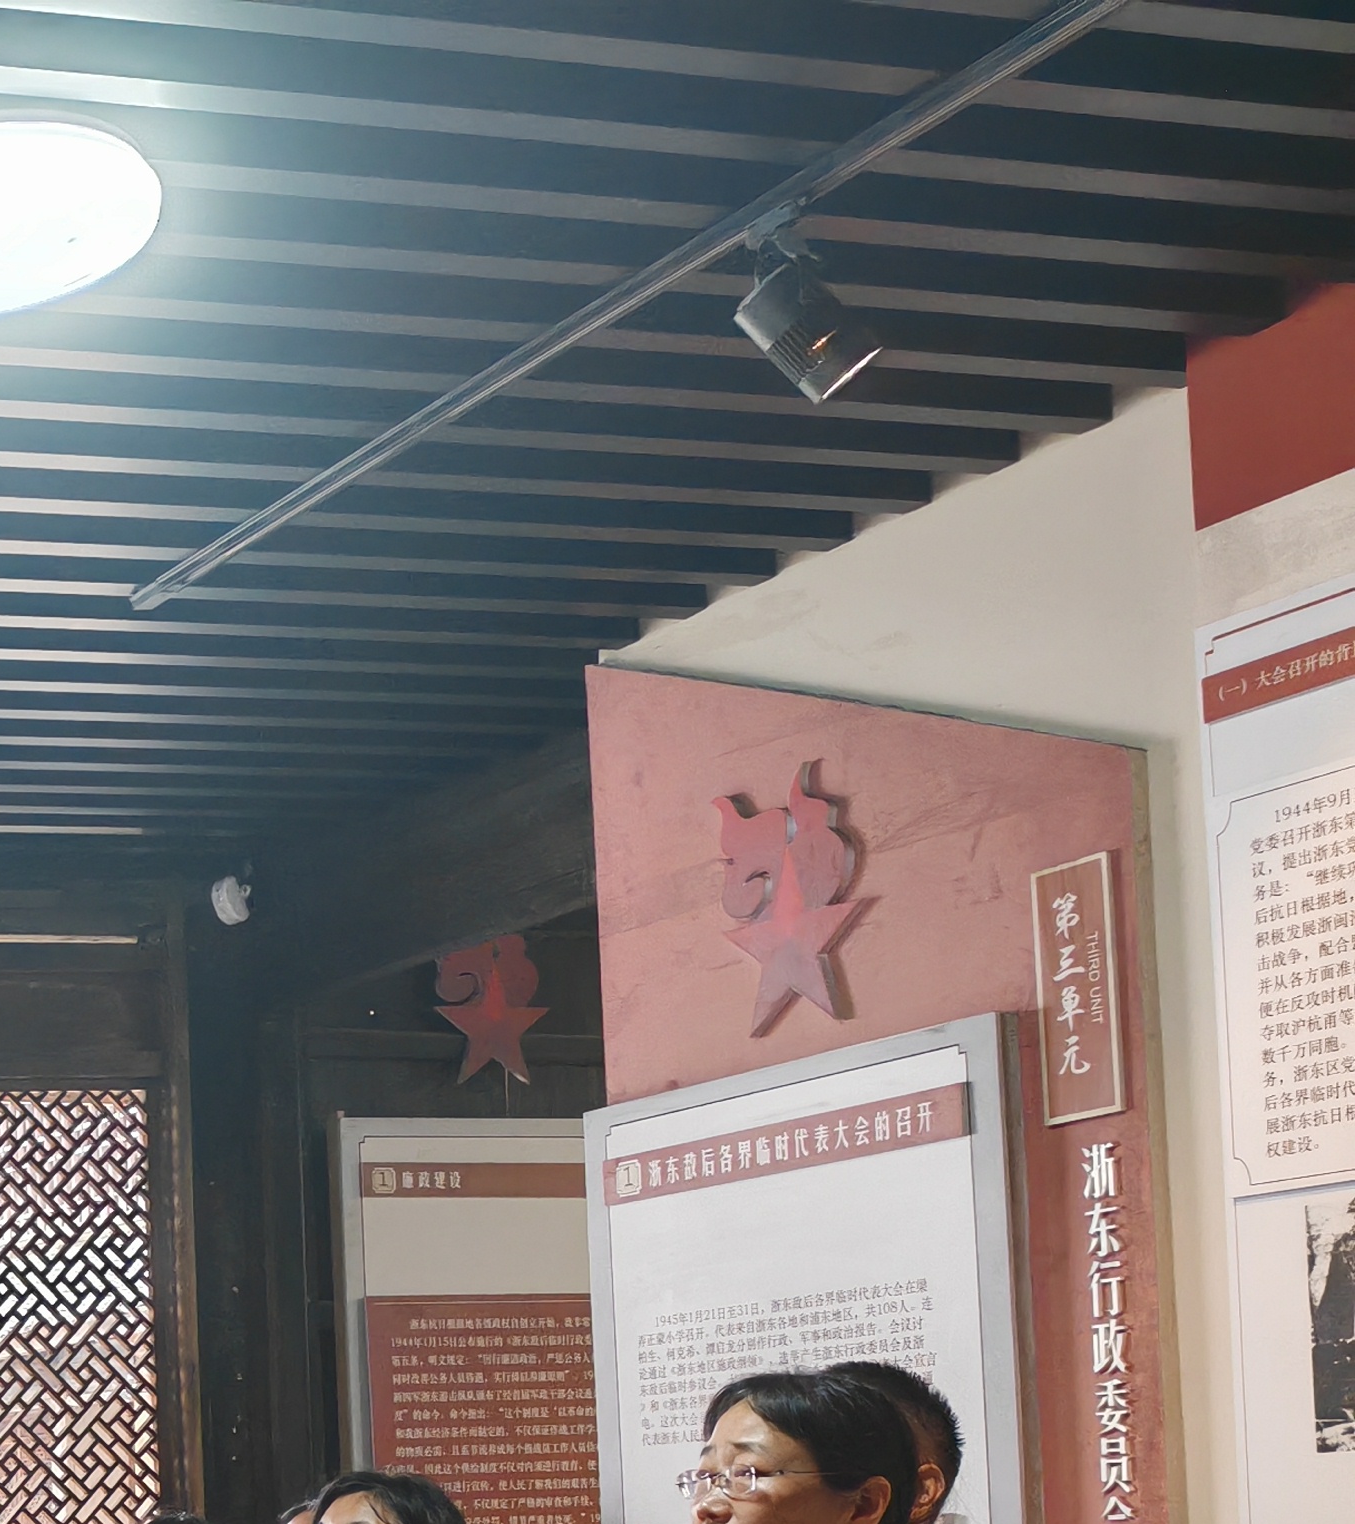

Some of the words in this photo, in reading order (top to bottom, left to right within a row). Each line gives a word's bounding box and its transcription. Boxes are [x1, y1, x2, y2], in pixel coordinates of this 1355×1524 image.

[1274, 787, 1355, 823] 1944年9月
[1084, 930, 1100, 982] THIRD
[1049, 891, 1091, 1077] 第三单元
[1257, 960, 1355, 996] 并从各方面准
[1088, 986, 1104, 1024] UNIT
[1258, 984, 1355, 1019] 便在反攻时机
[1261, 1035, 1348, 1066] 数千万同胞。
[647, 1101, 935, 1189] 浙东敌后各界临时代表大会的召开
[1265, 1135, 1320, 1159] 权建设。
[401, 1171, 462, 1190] 廉政建设
